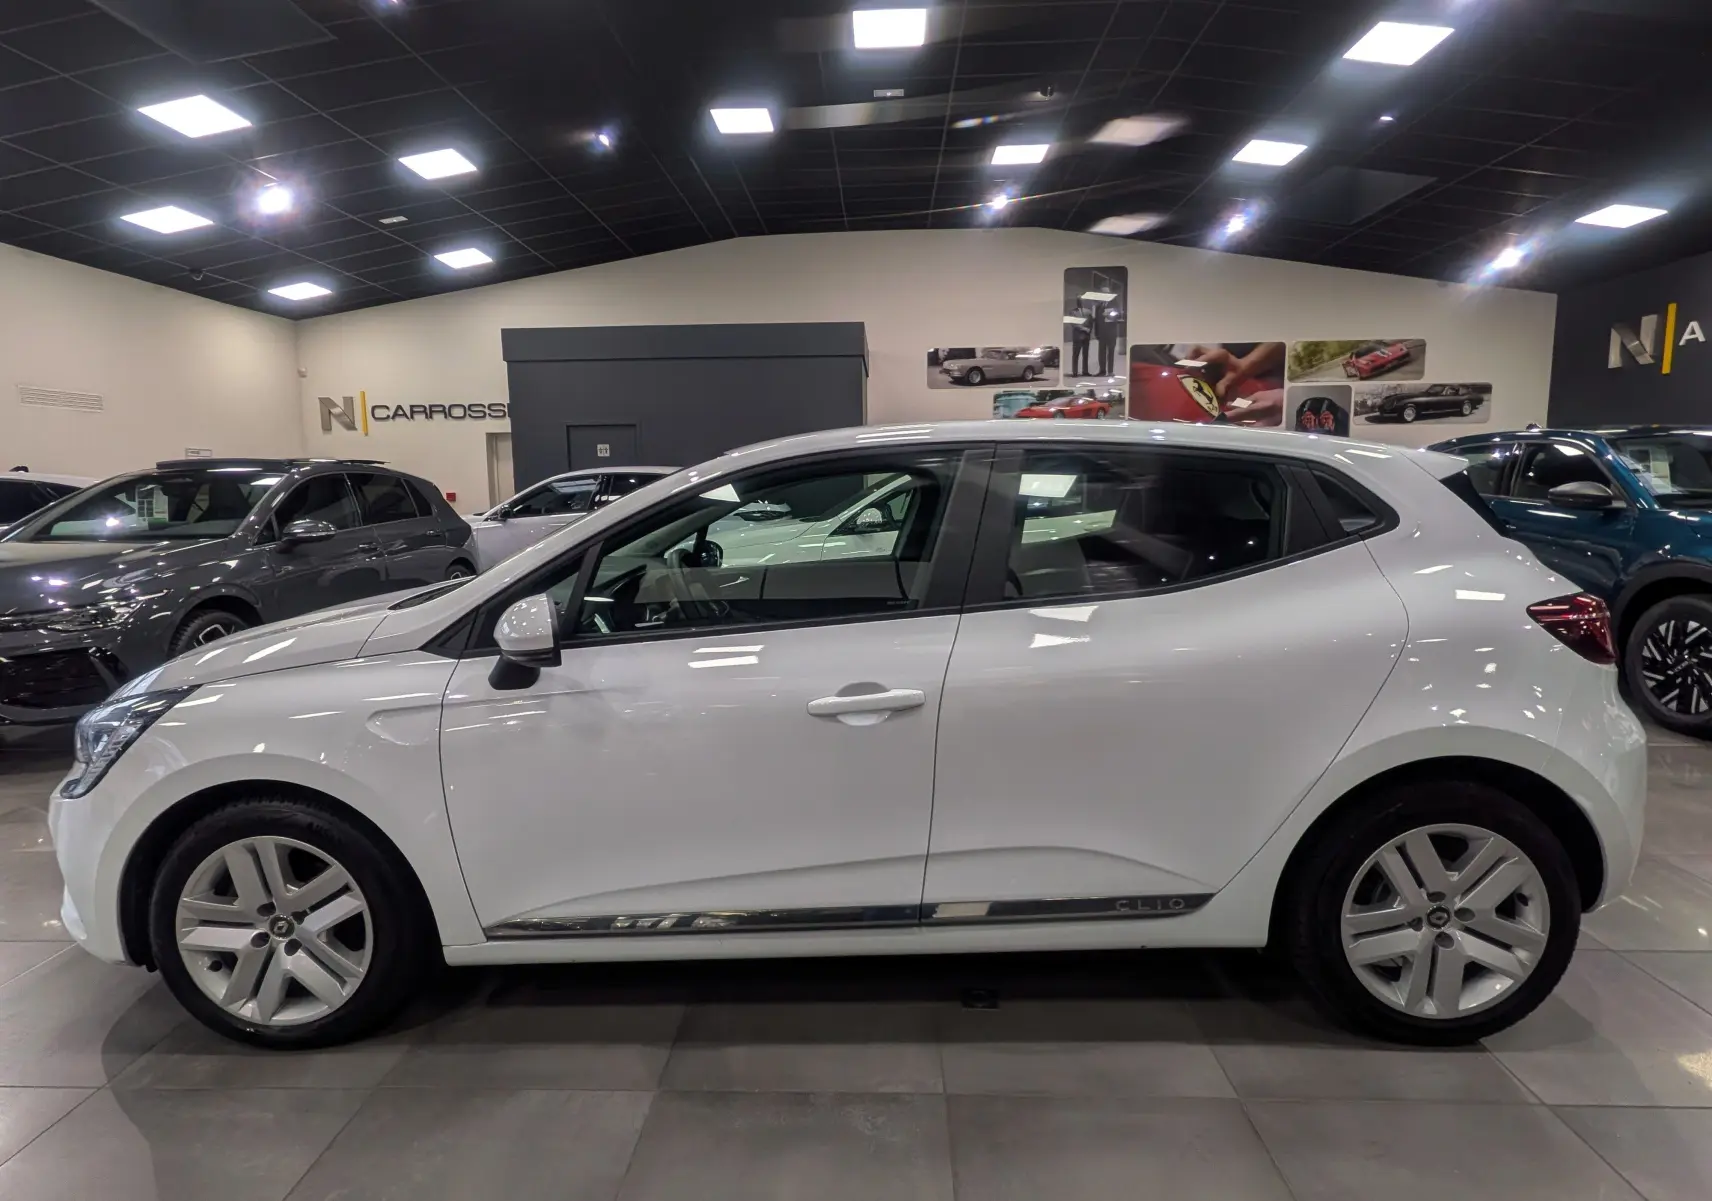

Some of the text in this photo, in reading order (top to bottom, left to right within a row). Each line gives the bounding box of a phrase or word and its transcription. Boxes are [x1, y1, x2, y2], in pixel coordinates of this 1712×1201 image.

[1608, 314, 1658, 369] N
[317, 396, 510, 432] N CARROSS
[1115, 898, 1185, 911] CLIO
